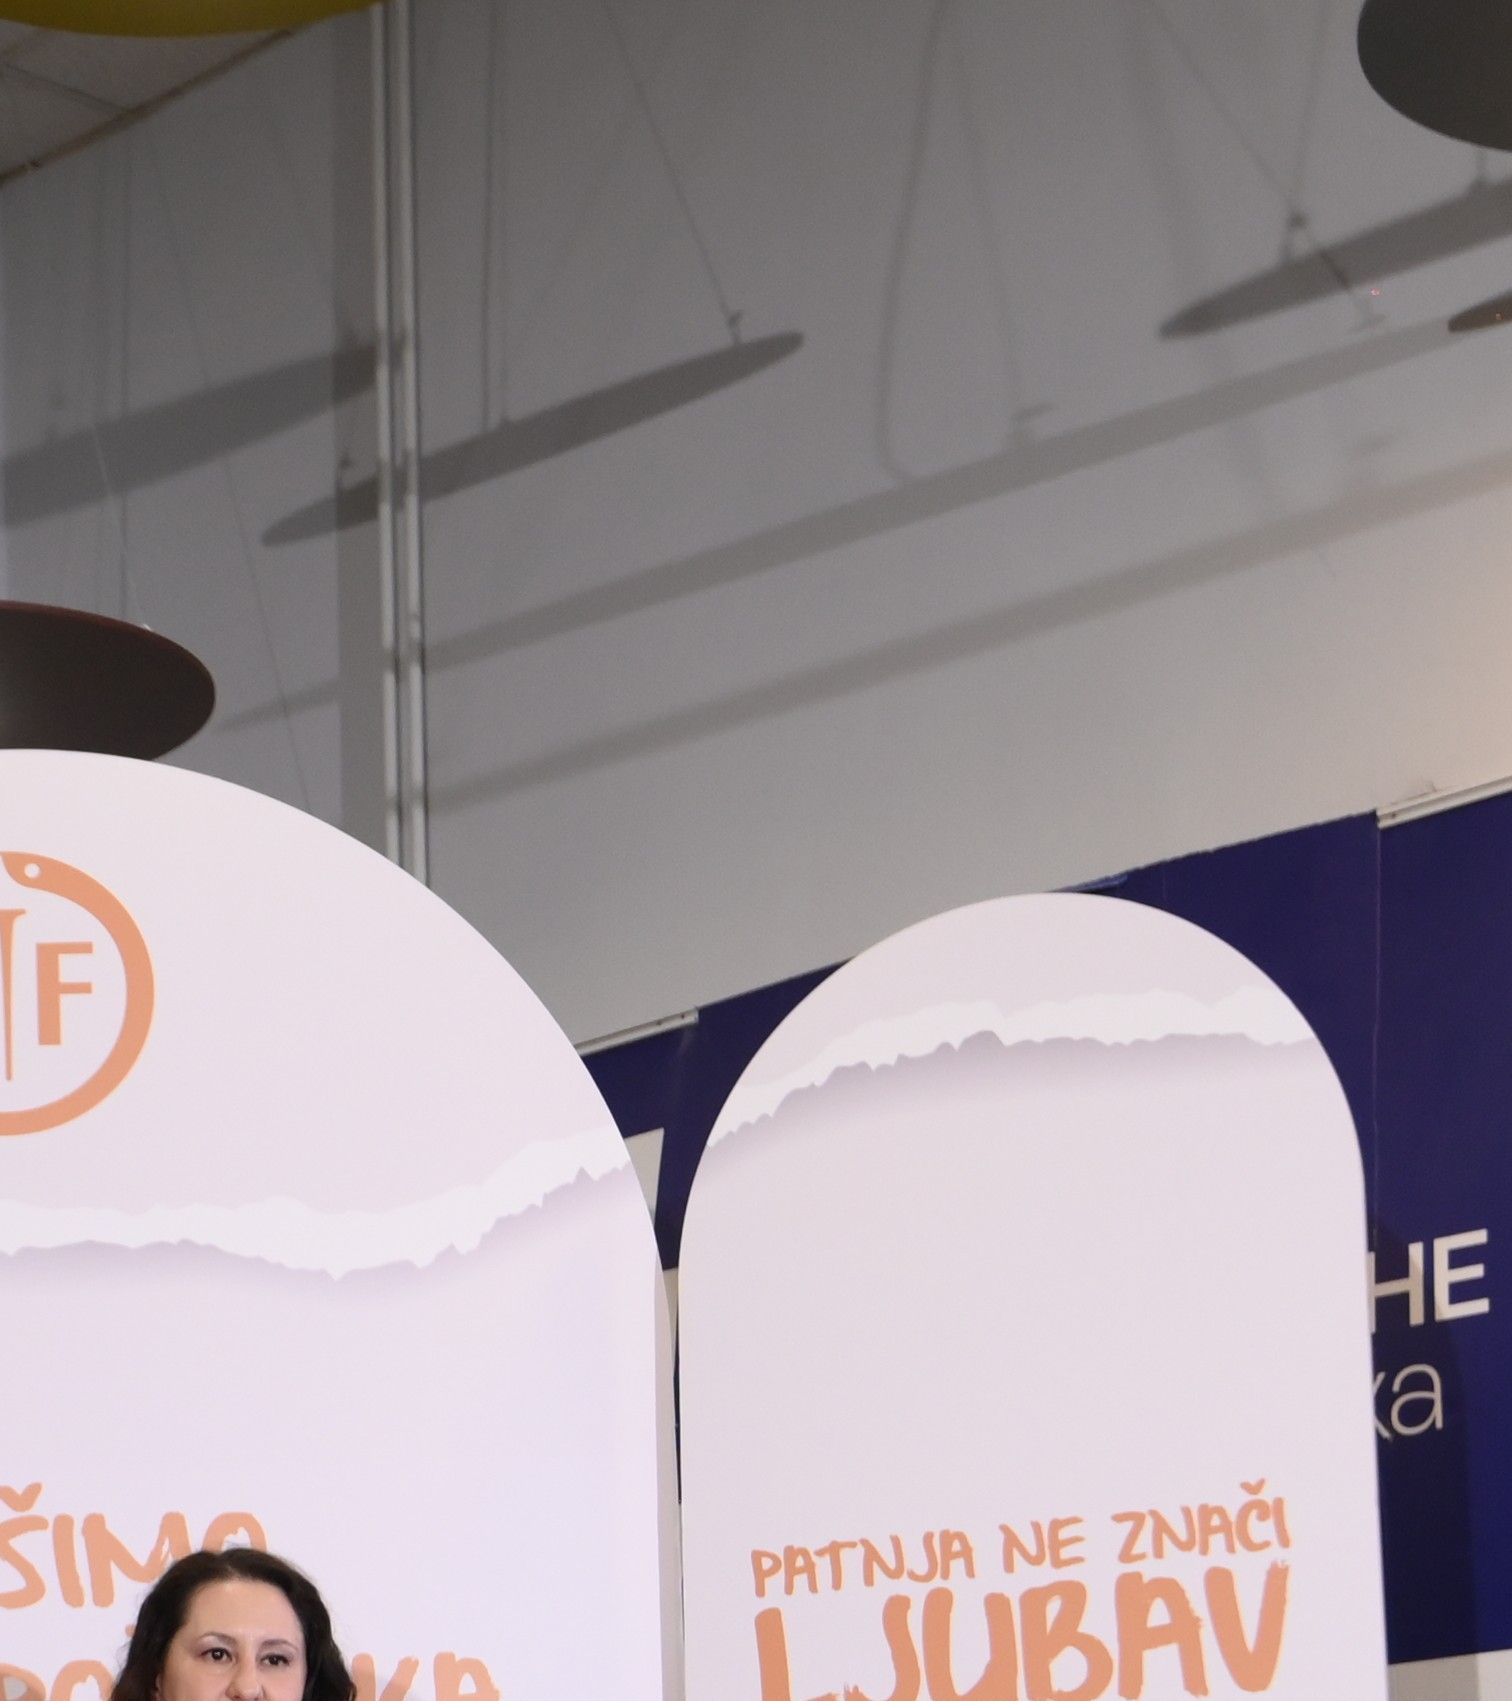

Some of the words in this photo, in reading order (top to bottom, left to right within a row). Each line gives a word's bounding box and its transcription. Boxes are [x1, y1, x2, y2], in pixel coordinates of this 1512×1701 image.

[751, 1529, 978, 1598] PATNJA
[1000, 1515, 1088, 1574] NE
[1112, 1478, 1294, 1564] ZNAČI
